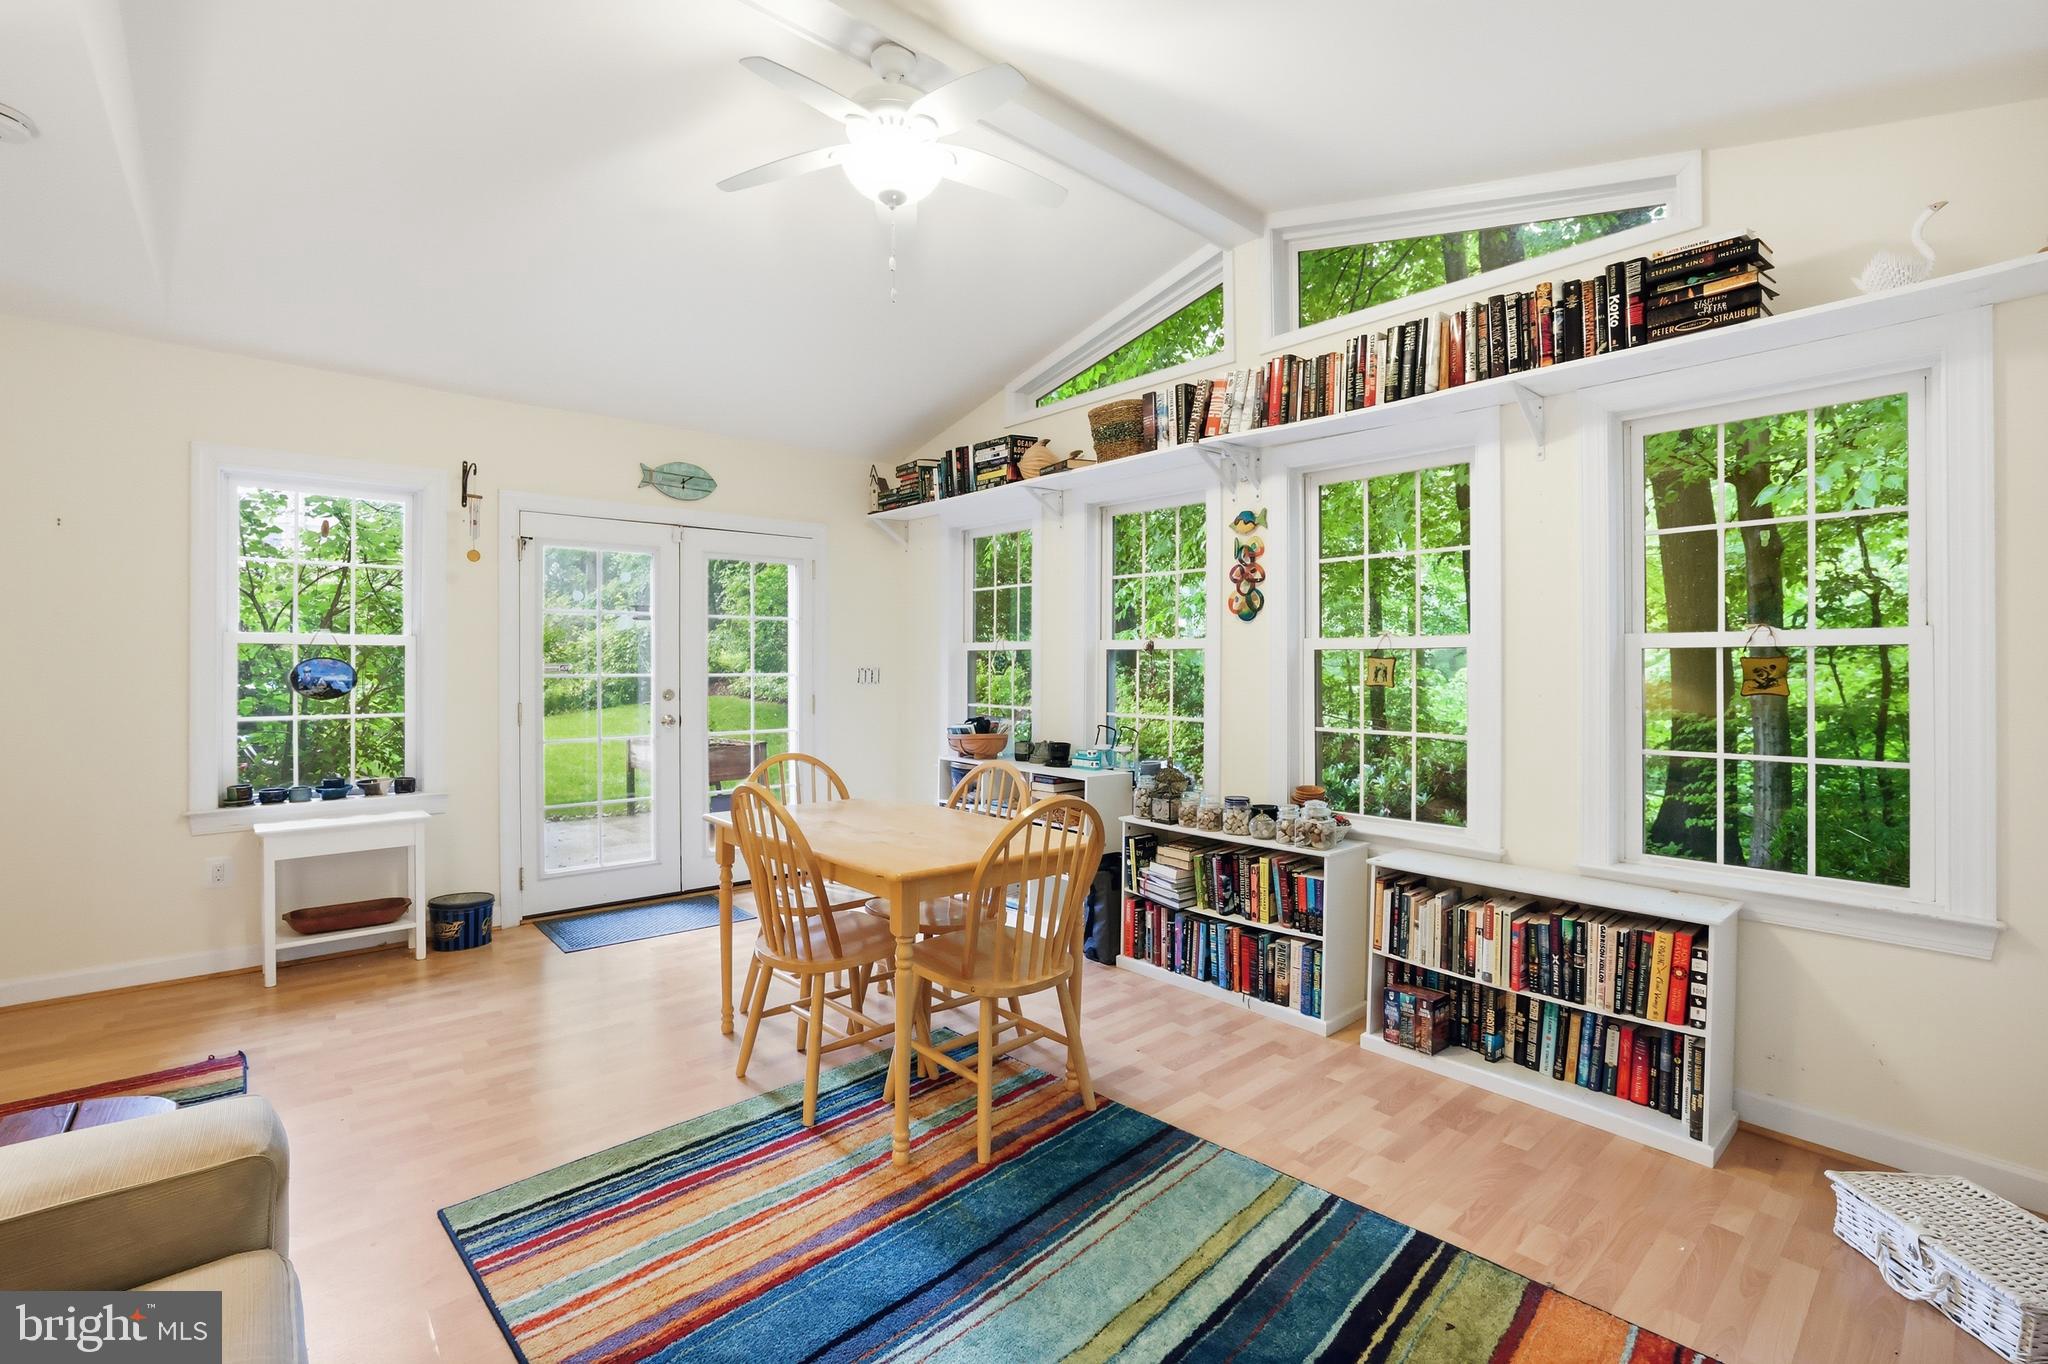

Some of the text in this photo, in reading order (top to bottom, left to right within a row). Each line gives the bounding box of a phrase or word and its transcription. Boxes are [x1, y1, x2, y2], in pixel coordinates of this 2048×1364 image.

[1691, 244, 1717, 255] STEPHEN
[1718, 245, 1751, 258] INSTITUTE
[1651, 259, 1705, 276] STEPHEN KING
[1608, 294, 1619, 328] KOKO
[1714, 310, 1746, 323] STRAUB
[1652, 327, 1674, 337] PETER
[1210, 392, 1222, 418] KING
[1276, 944, 1286, 980] PANDEMIC
